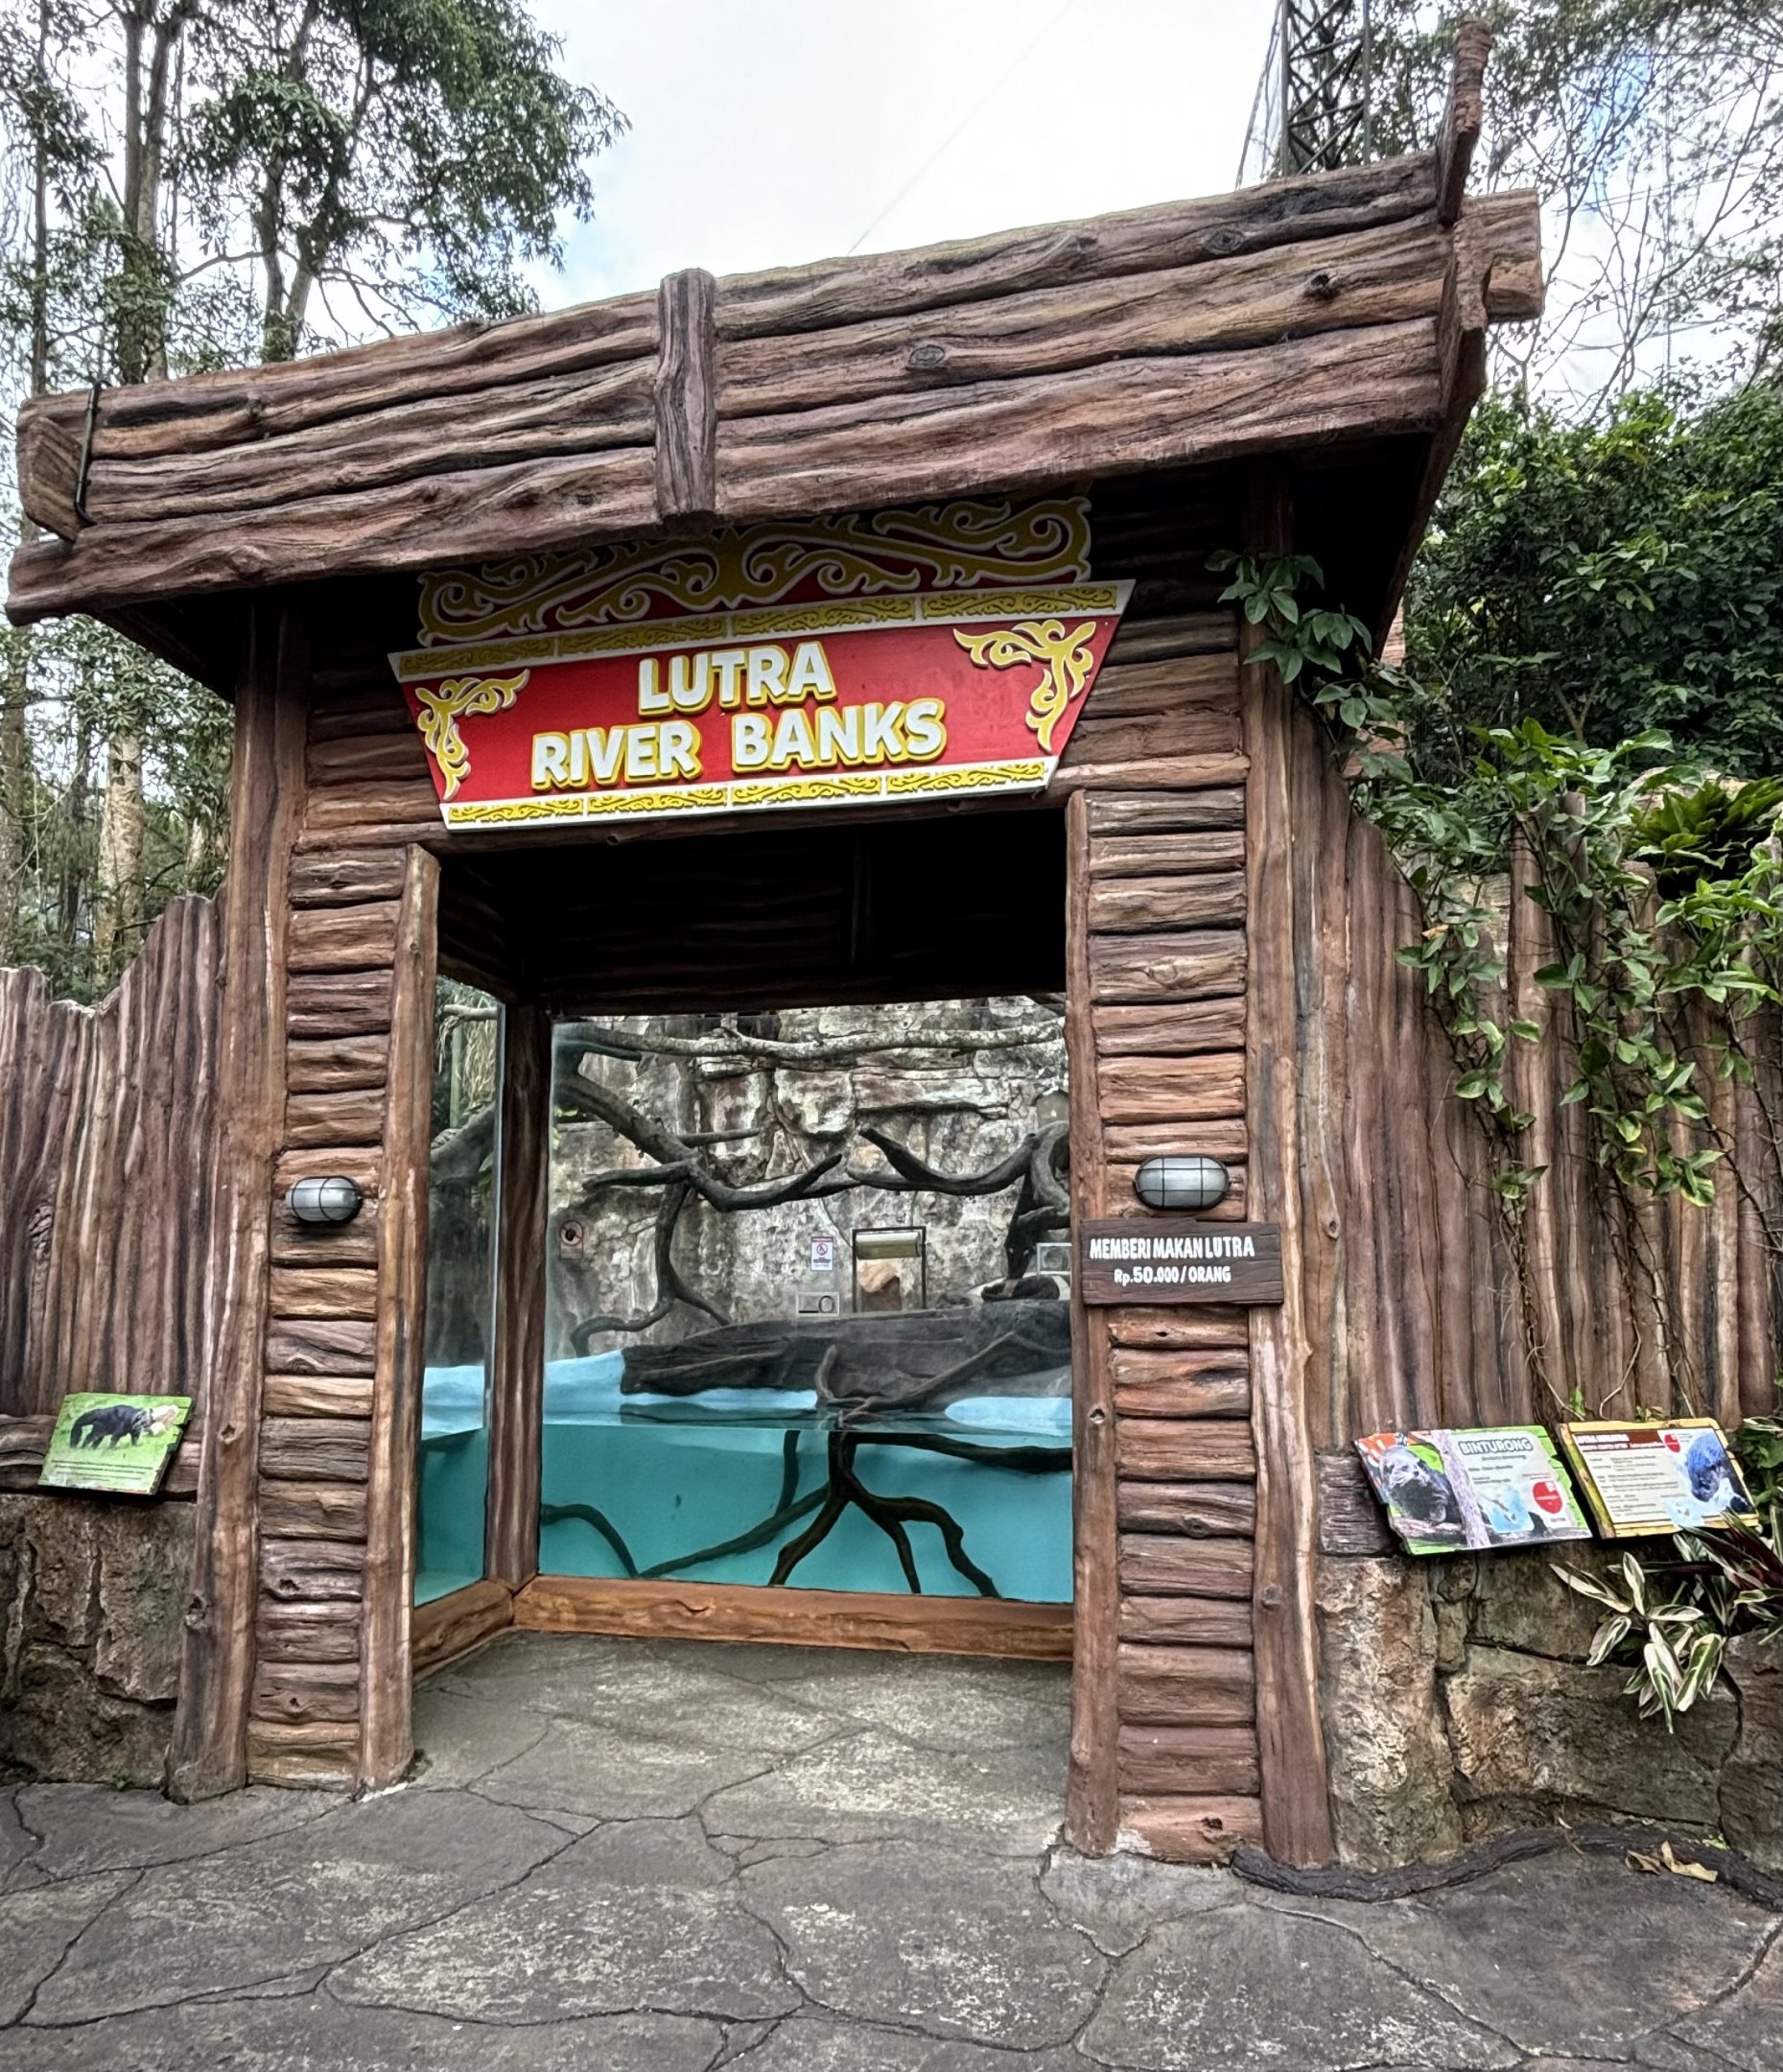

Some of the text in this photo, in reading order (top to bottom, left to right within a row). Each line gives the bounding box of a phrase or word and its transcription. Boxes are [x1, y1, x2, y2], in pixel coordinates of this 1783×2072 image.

[638, 640, 836, 717] LUTRA
[530, 698, 947, 789] RIVER BANKS
[1089, 1236, 1255, 1260] MEMBERI MAKAN LUTRA
[1458, 1438, 1534, 1455] BINTURONG
